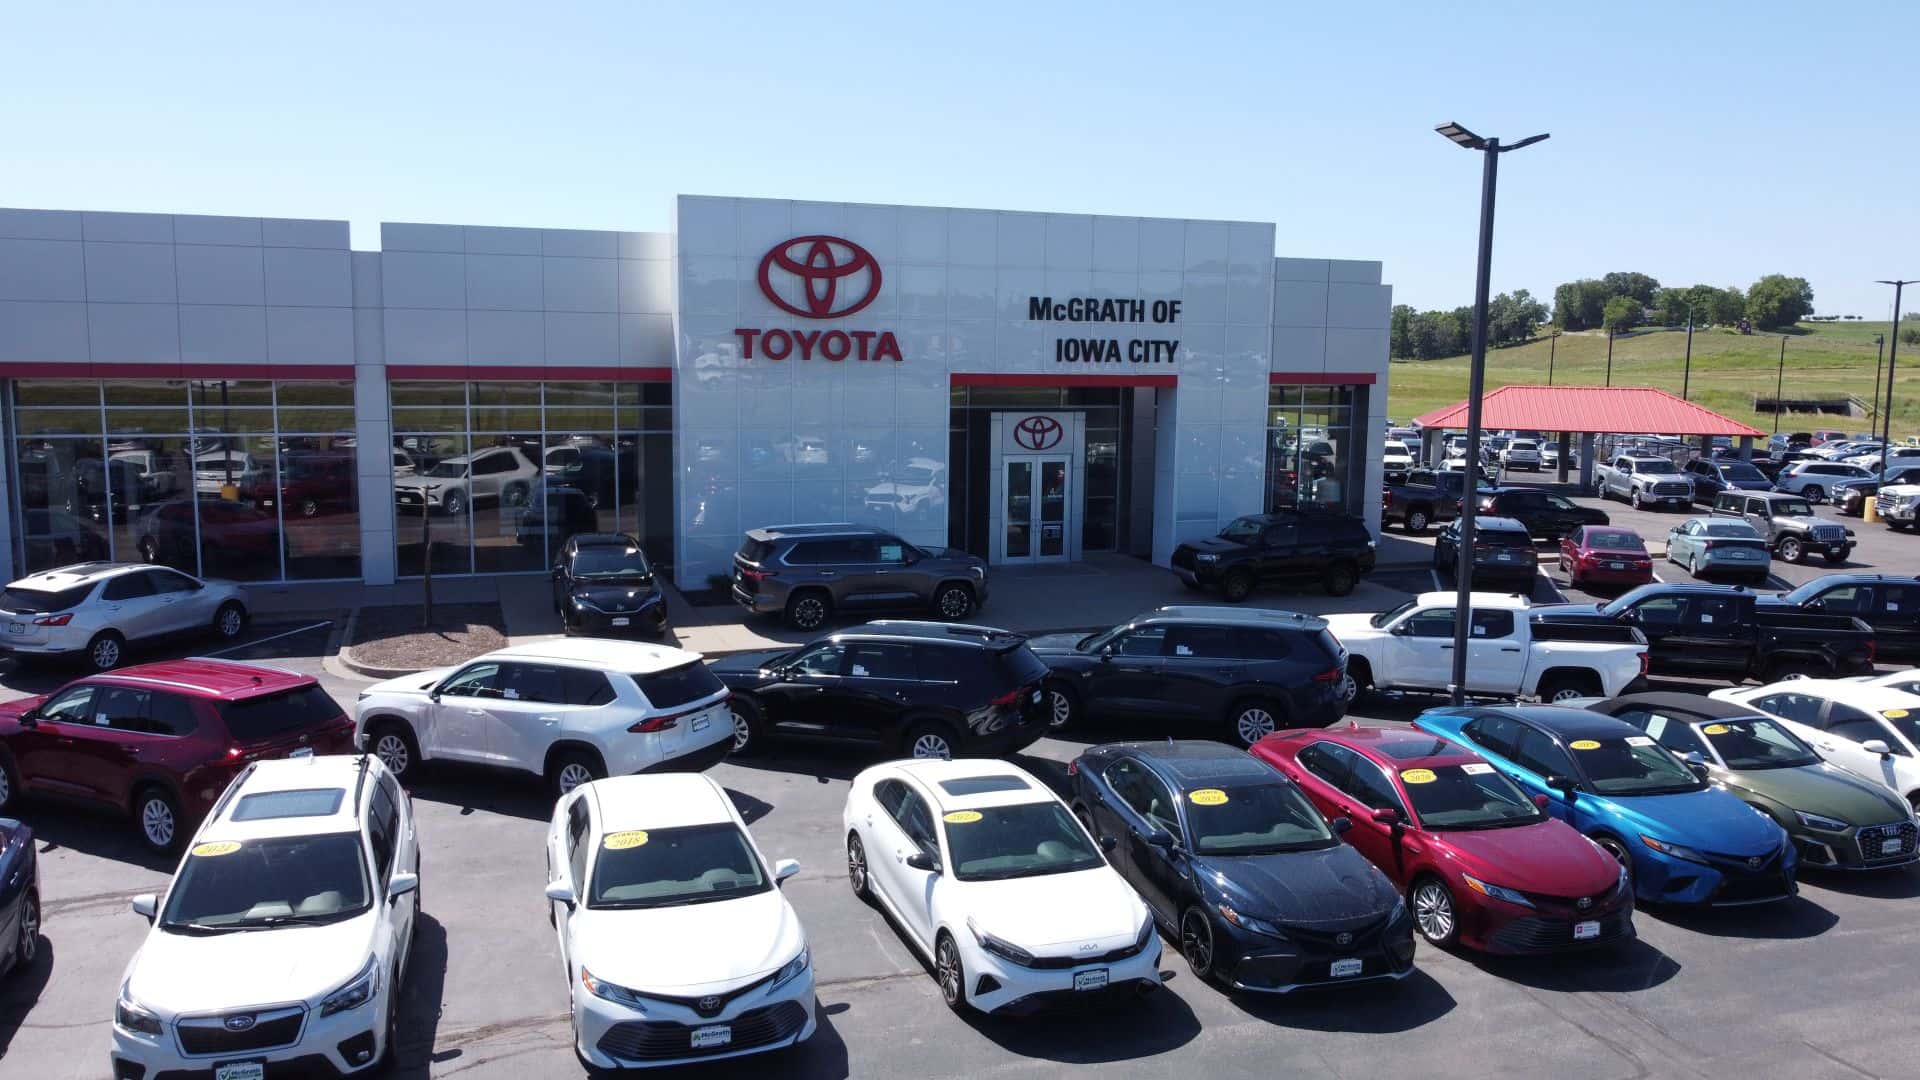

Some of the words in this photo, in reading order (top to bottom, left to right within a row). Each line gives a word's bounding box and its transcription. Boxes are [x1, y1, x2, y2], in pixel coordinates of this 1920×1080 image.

[1029, 296, 1145, 323] McGRATH
[1152, 299, 1182, 323] OF
[734, 328, 903, 362] TOYOTA
[1056, 338, 1122, 363] IOWA
[1128, 339, 1179, 363] CITY
